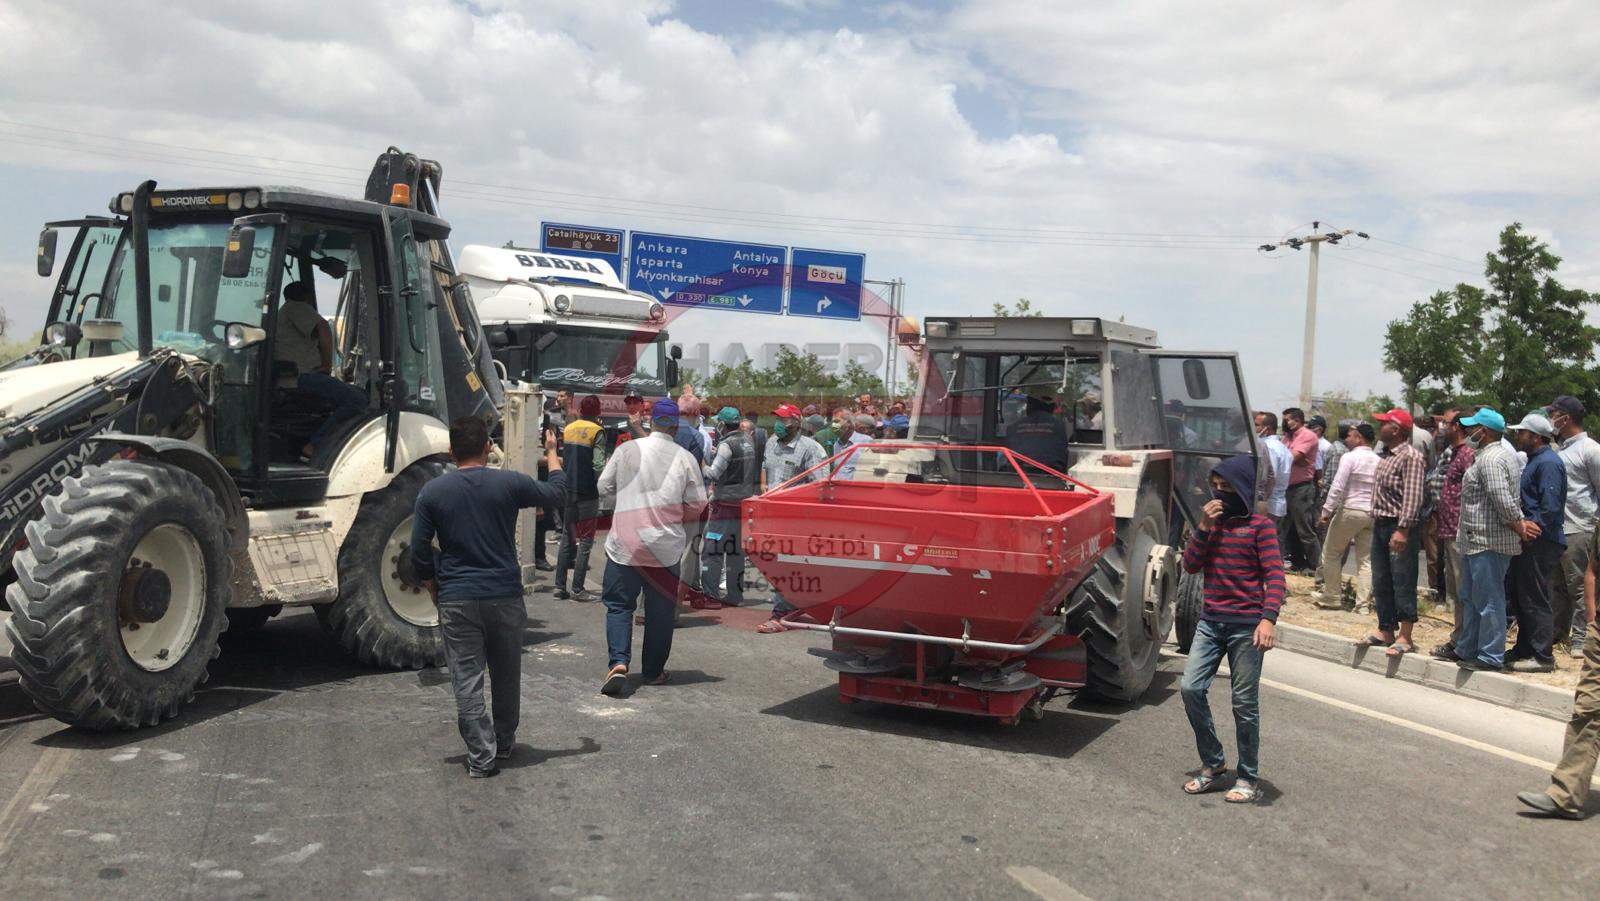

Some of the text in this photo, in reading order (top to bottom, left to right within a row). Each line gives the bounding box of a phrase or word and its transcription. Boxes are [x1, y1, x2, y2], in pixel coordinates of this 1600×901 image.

[605, 234, 618, 243] 23
[637, 240, 688, 255] Ankara
[515, 254, 604, 275] SERRA
[636, 255, 683, 269] Isparta
[733, 250, 779, 265] Antalya
[636, 268, 724, 286] Afyonkarahisar
[732, 263, 769, 278] Konya
[811, 268, 843, 281] Göçü
